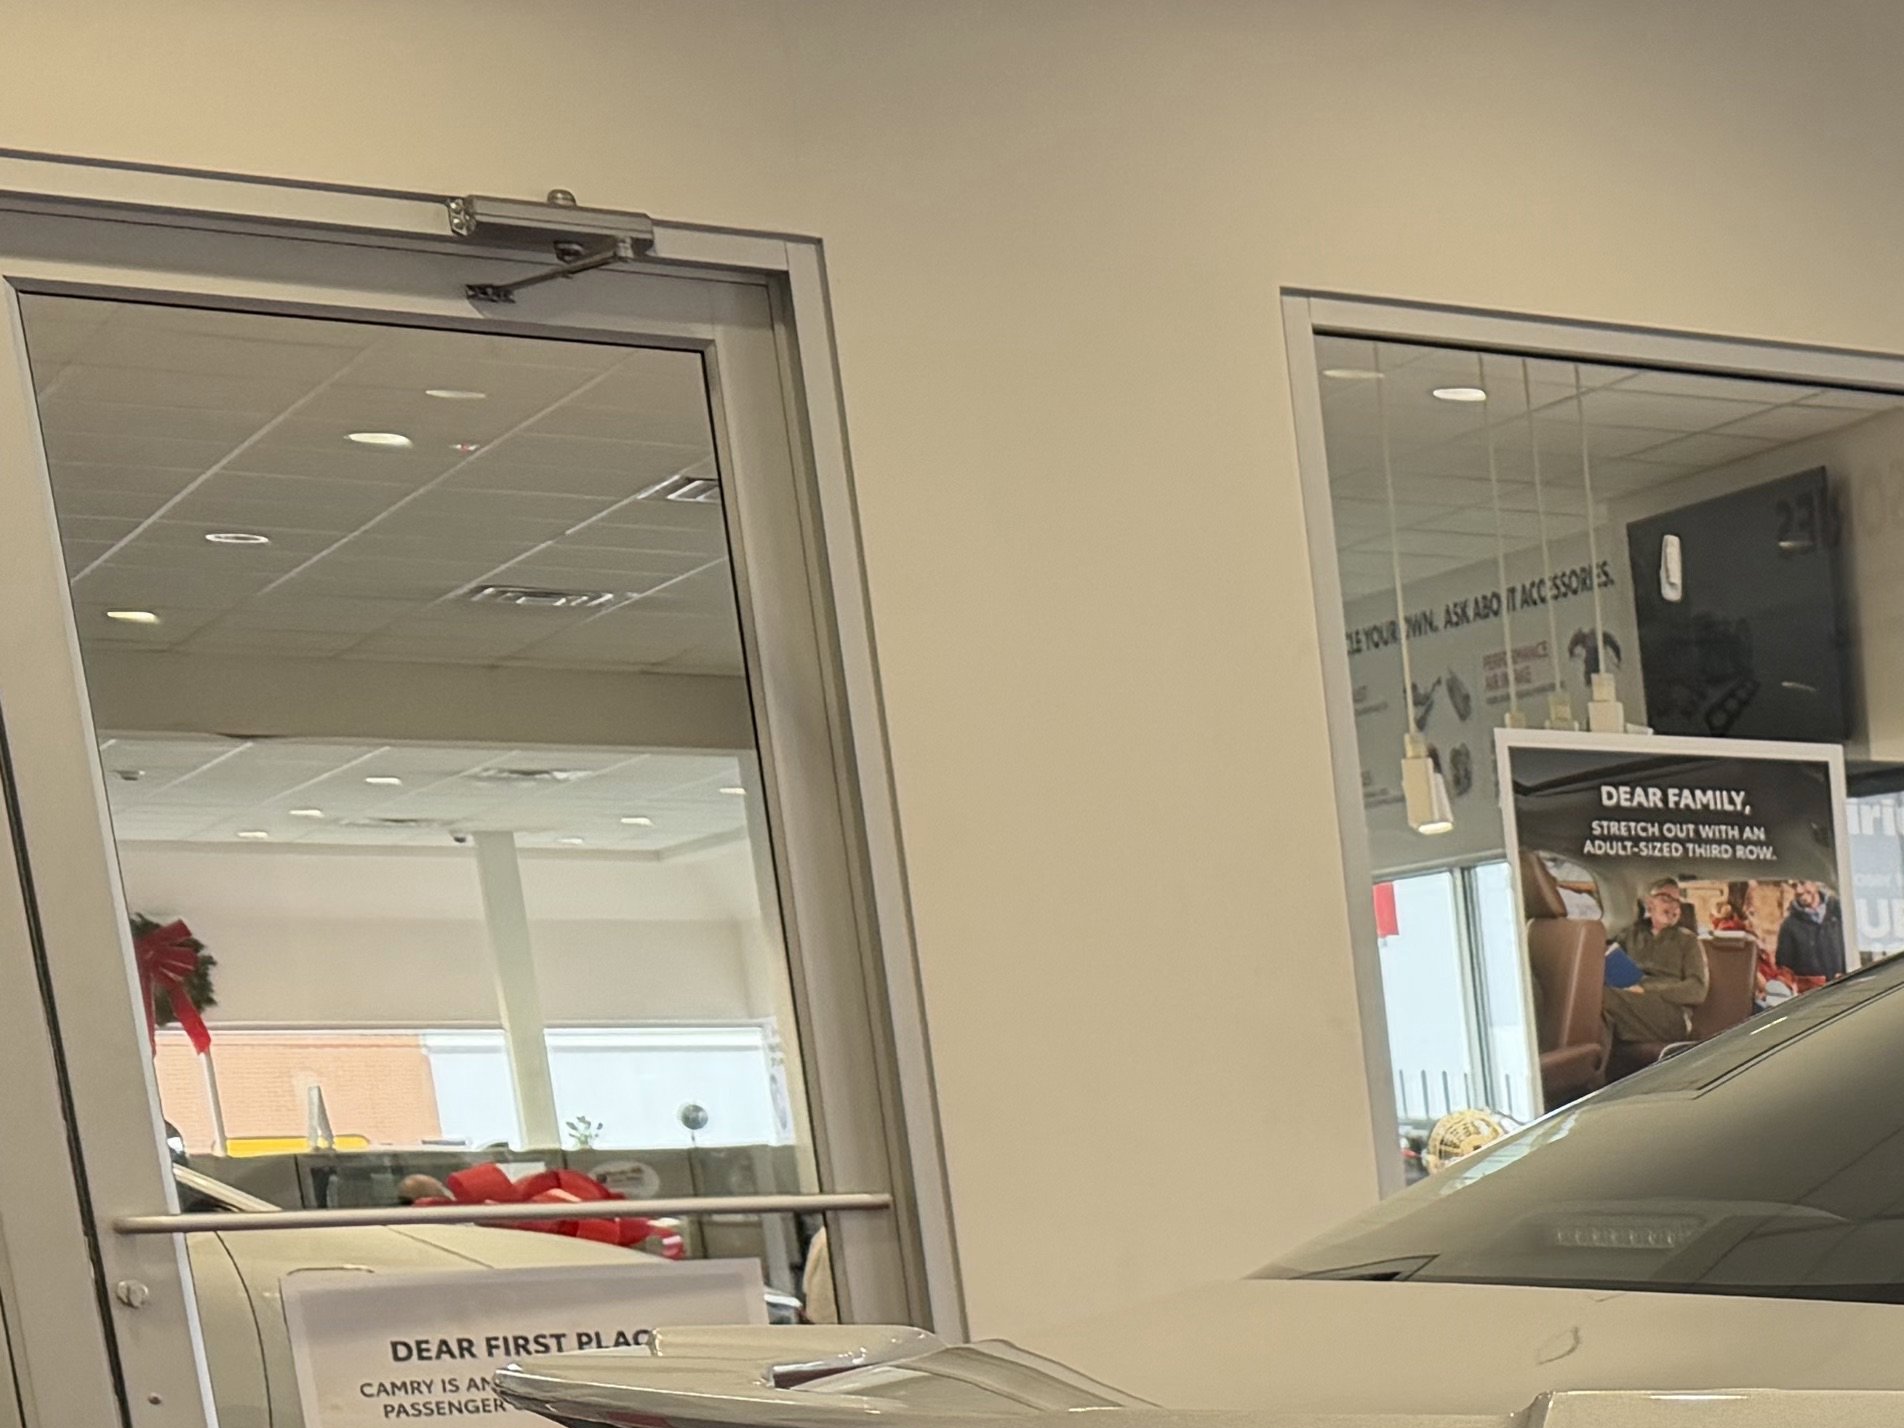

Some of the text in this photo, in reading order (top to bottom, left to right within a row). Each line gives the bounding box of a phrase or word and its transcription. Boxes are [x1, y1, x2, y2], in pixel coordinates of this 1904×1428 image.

[1443, 597, 1470, 631] ASK
[1519, 560, 1616, 610] ACCSSORIS.
[1600, 785, 1752, 815] DEAR FAMILY,
[1591, 819, 1767, 841] STRETCH OUT WITH AN
[1583, 839, 1778, 860] ADULT-SIZED THIRD ROW.
[390, 1338, 478, 1363] DEAR
[486, 1332, 567, 1358] FIRST
[359, 1378, 433, 1399] CAMRY
[441, 1376, 461, 1394] IS
[383, 1398, 507, 1420] PASSENGER
